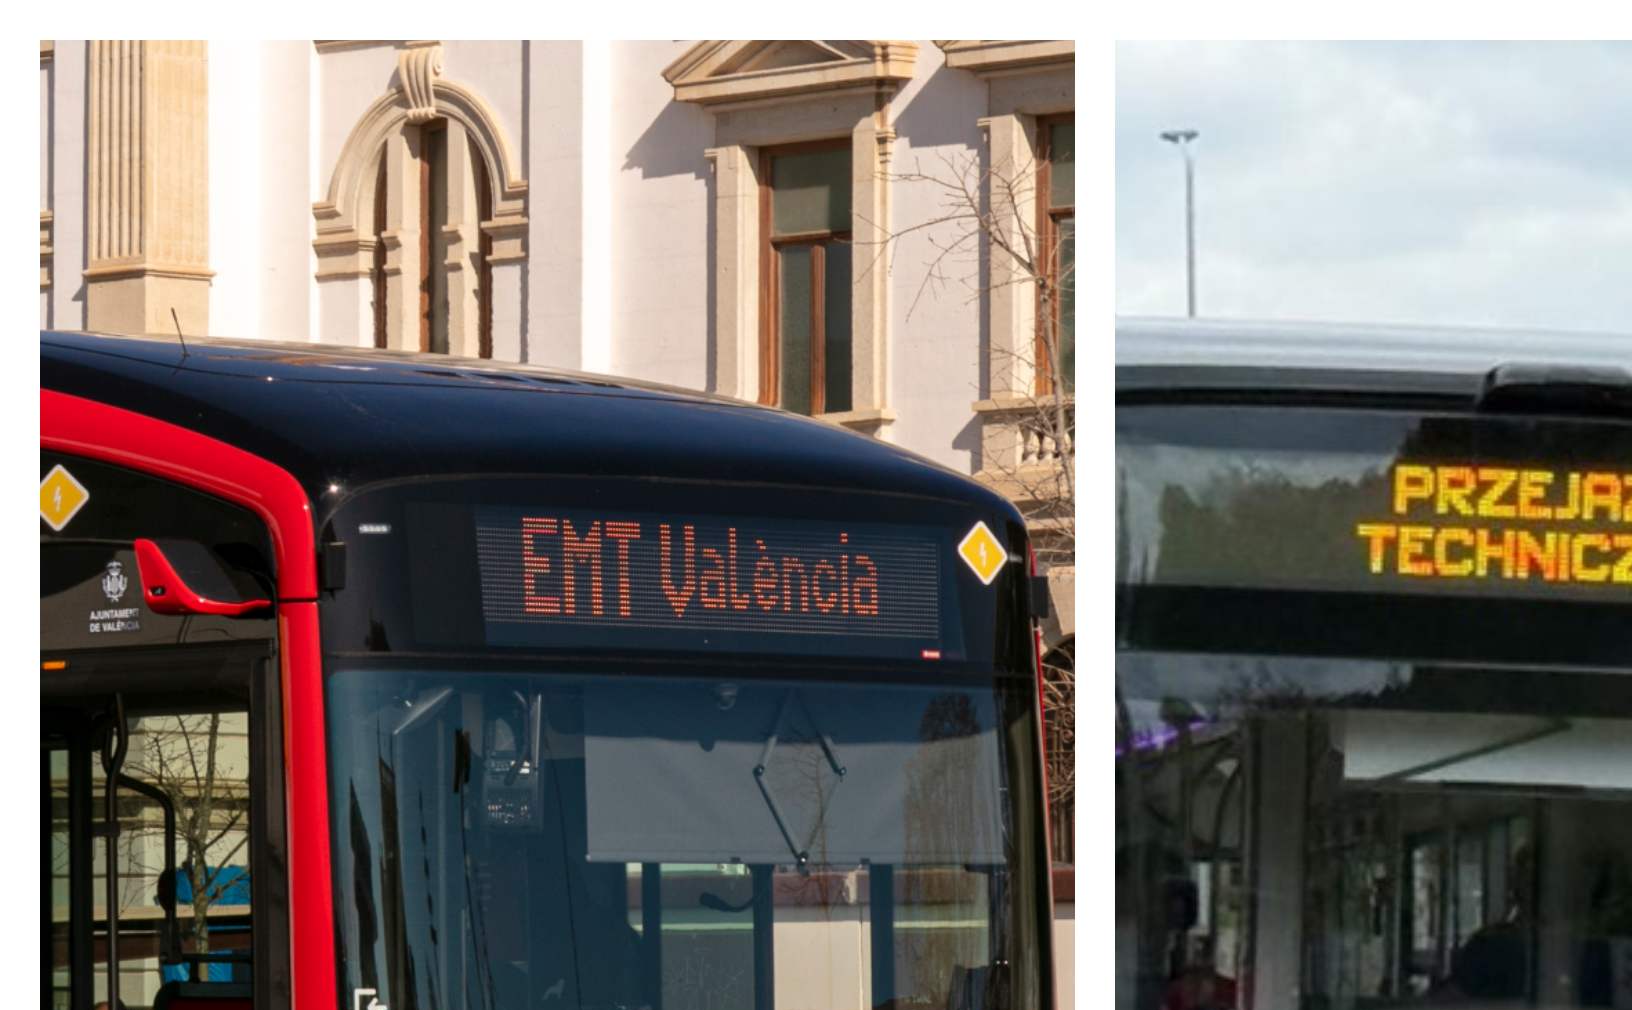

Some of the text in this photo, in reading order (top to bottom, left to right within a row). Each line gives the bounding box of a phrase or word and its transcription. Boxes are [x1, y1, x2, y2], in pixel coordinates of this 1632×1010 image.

[522, 516, 878, 618] EMT València
[89, 607, 139, 621] AJUNTAMENT
[89, 622, 101, 633] DE
